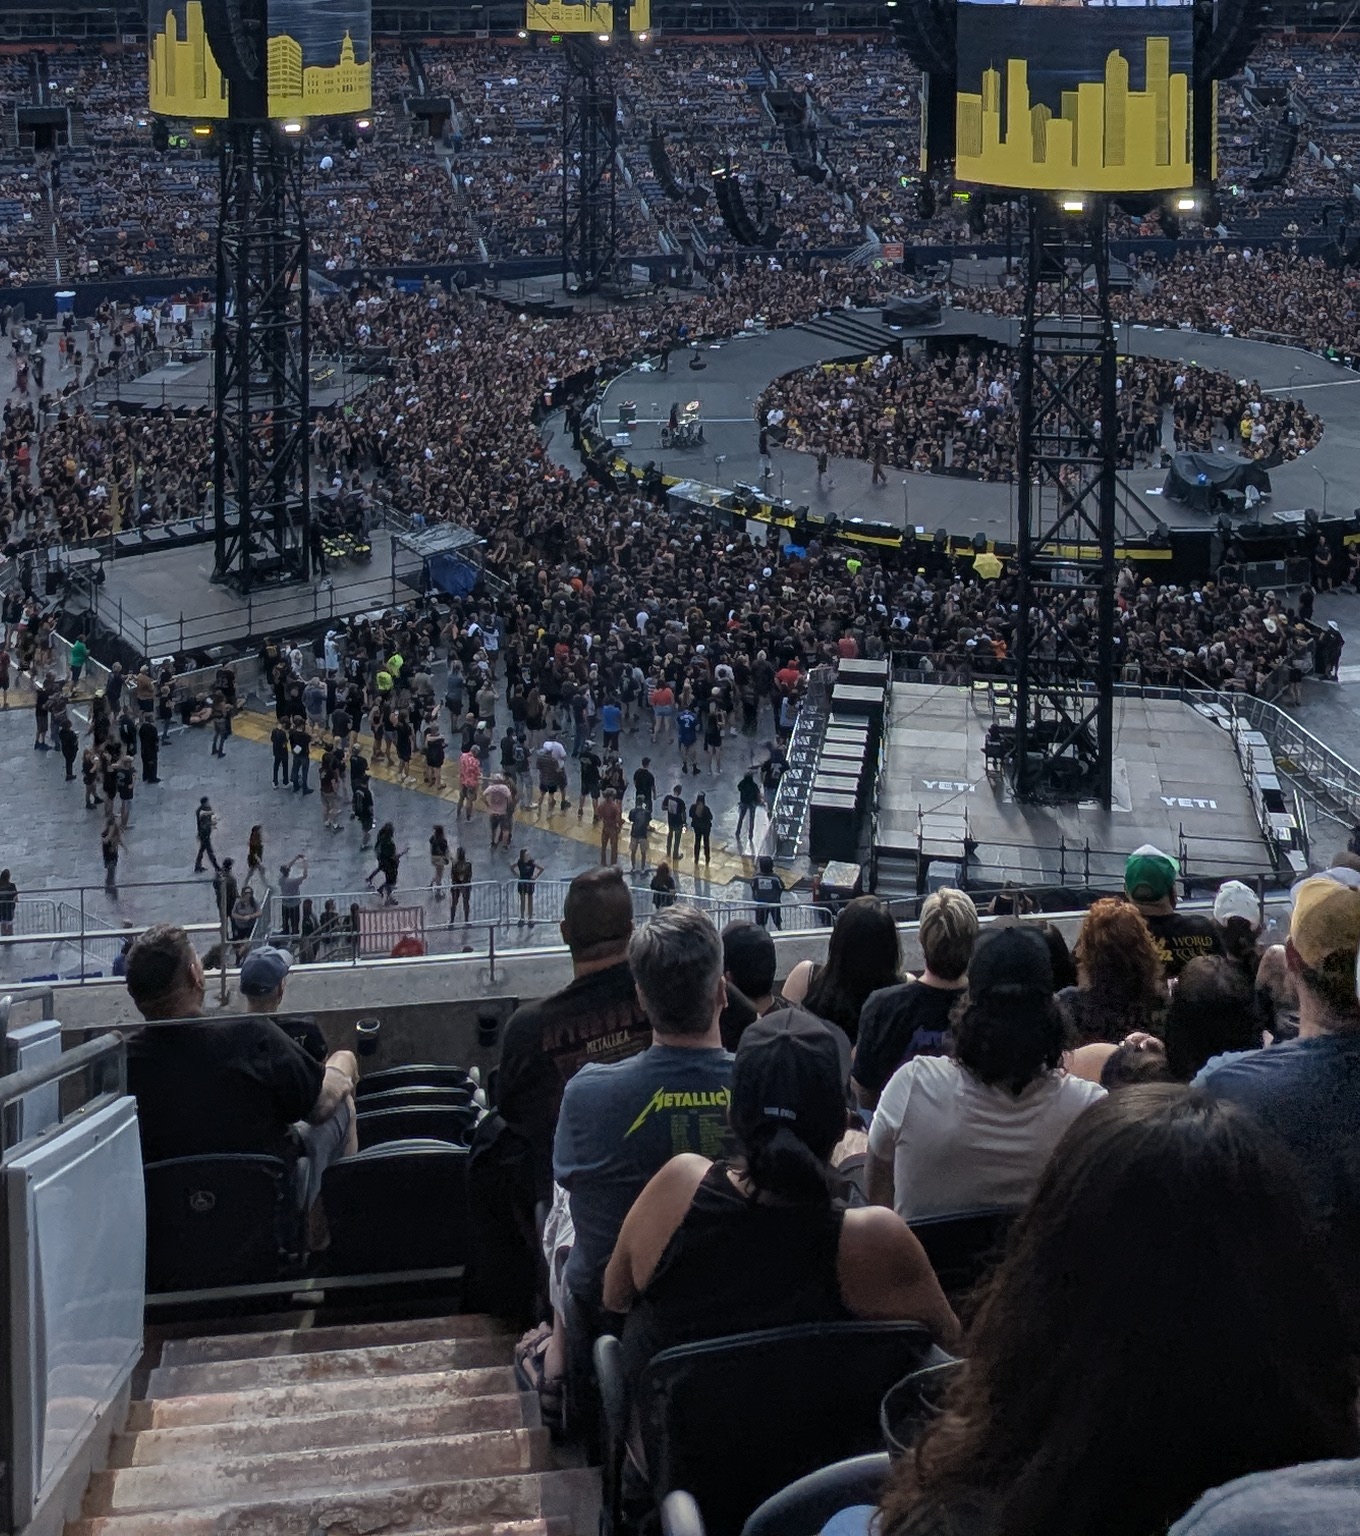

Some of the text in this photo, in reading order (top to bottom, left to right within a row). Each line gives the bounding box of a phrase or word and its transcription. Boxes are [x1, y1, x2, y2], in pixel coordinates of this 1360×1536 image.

[921, 779, 976, 792] YETI
[1159, 795, 1218, 809] YETI
[1172, 936, 1213, 947] WORLD
[623, 1085, 731, 1138] METALLIC
